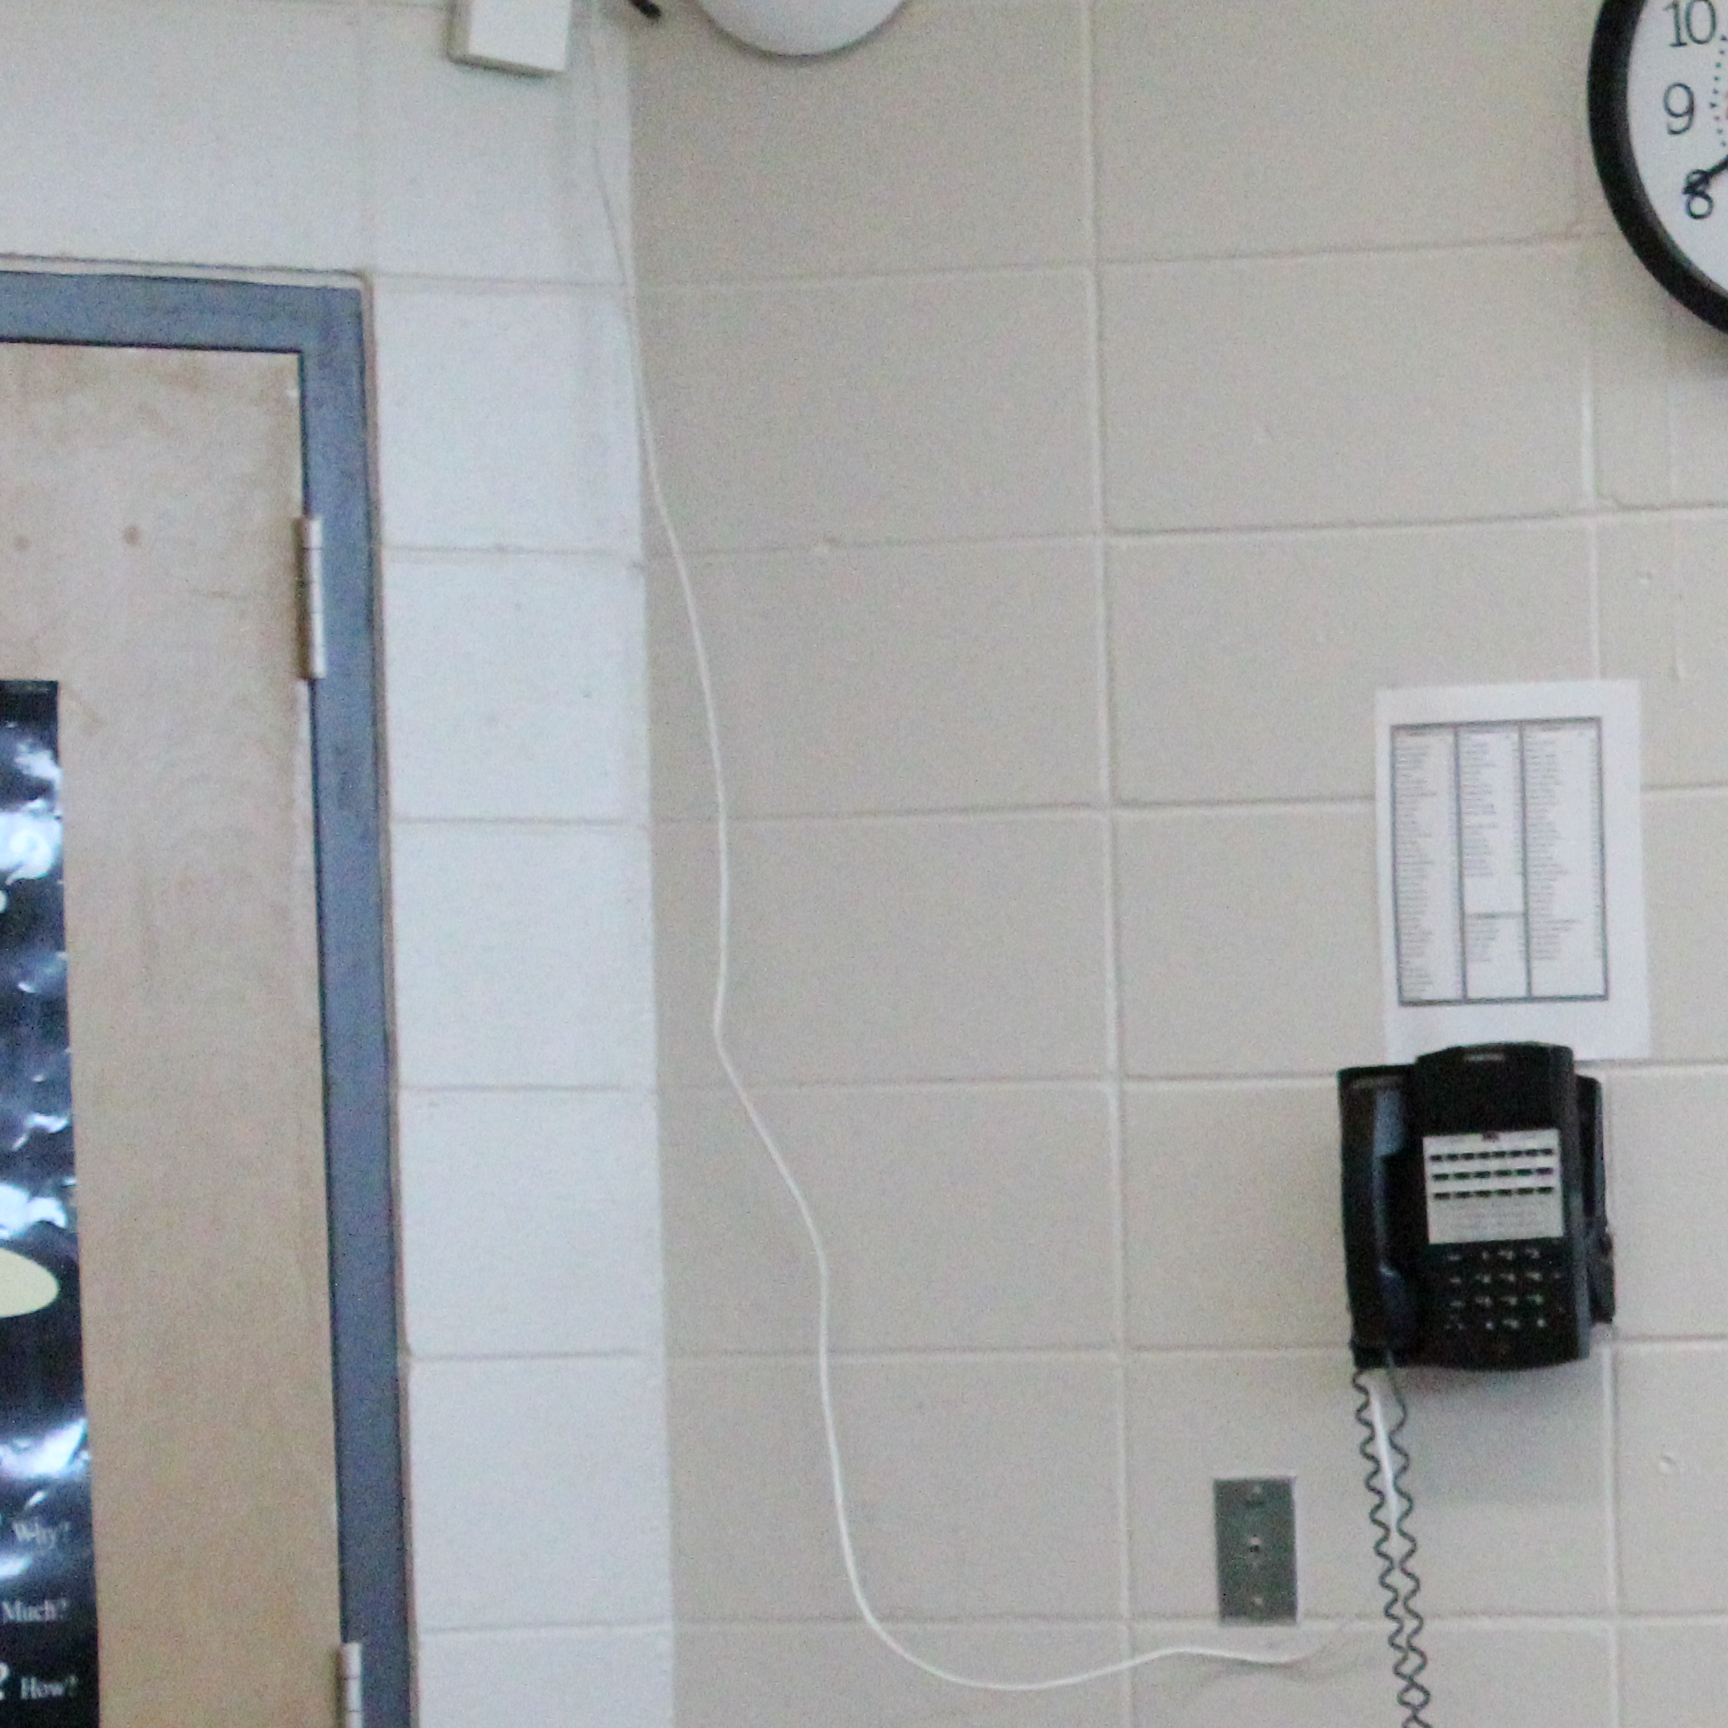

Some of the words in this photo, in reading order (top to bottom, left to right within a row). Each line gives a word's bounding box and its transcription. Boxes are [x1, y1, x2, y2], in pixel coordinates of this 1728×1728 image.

[1663, 0, 1717, 47] 10
[1663, 83, 1695, 135] 9
[1682, 169, 1714, 219] 8
[21, 1675, 78, 1699] How?
